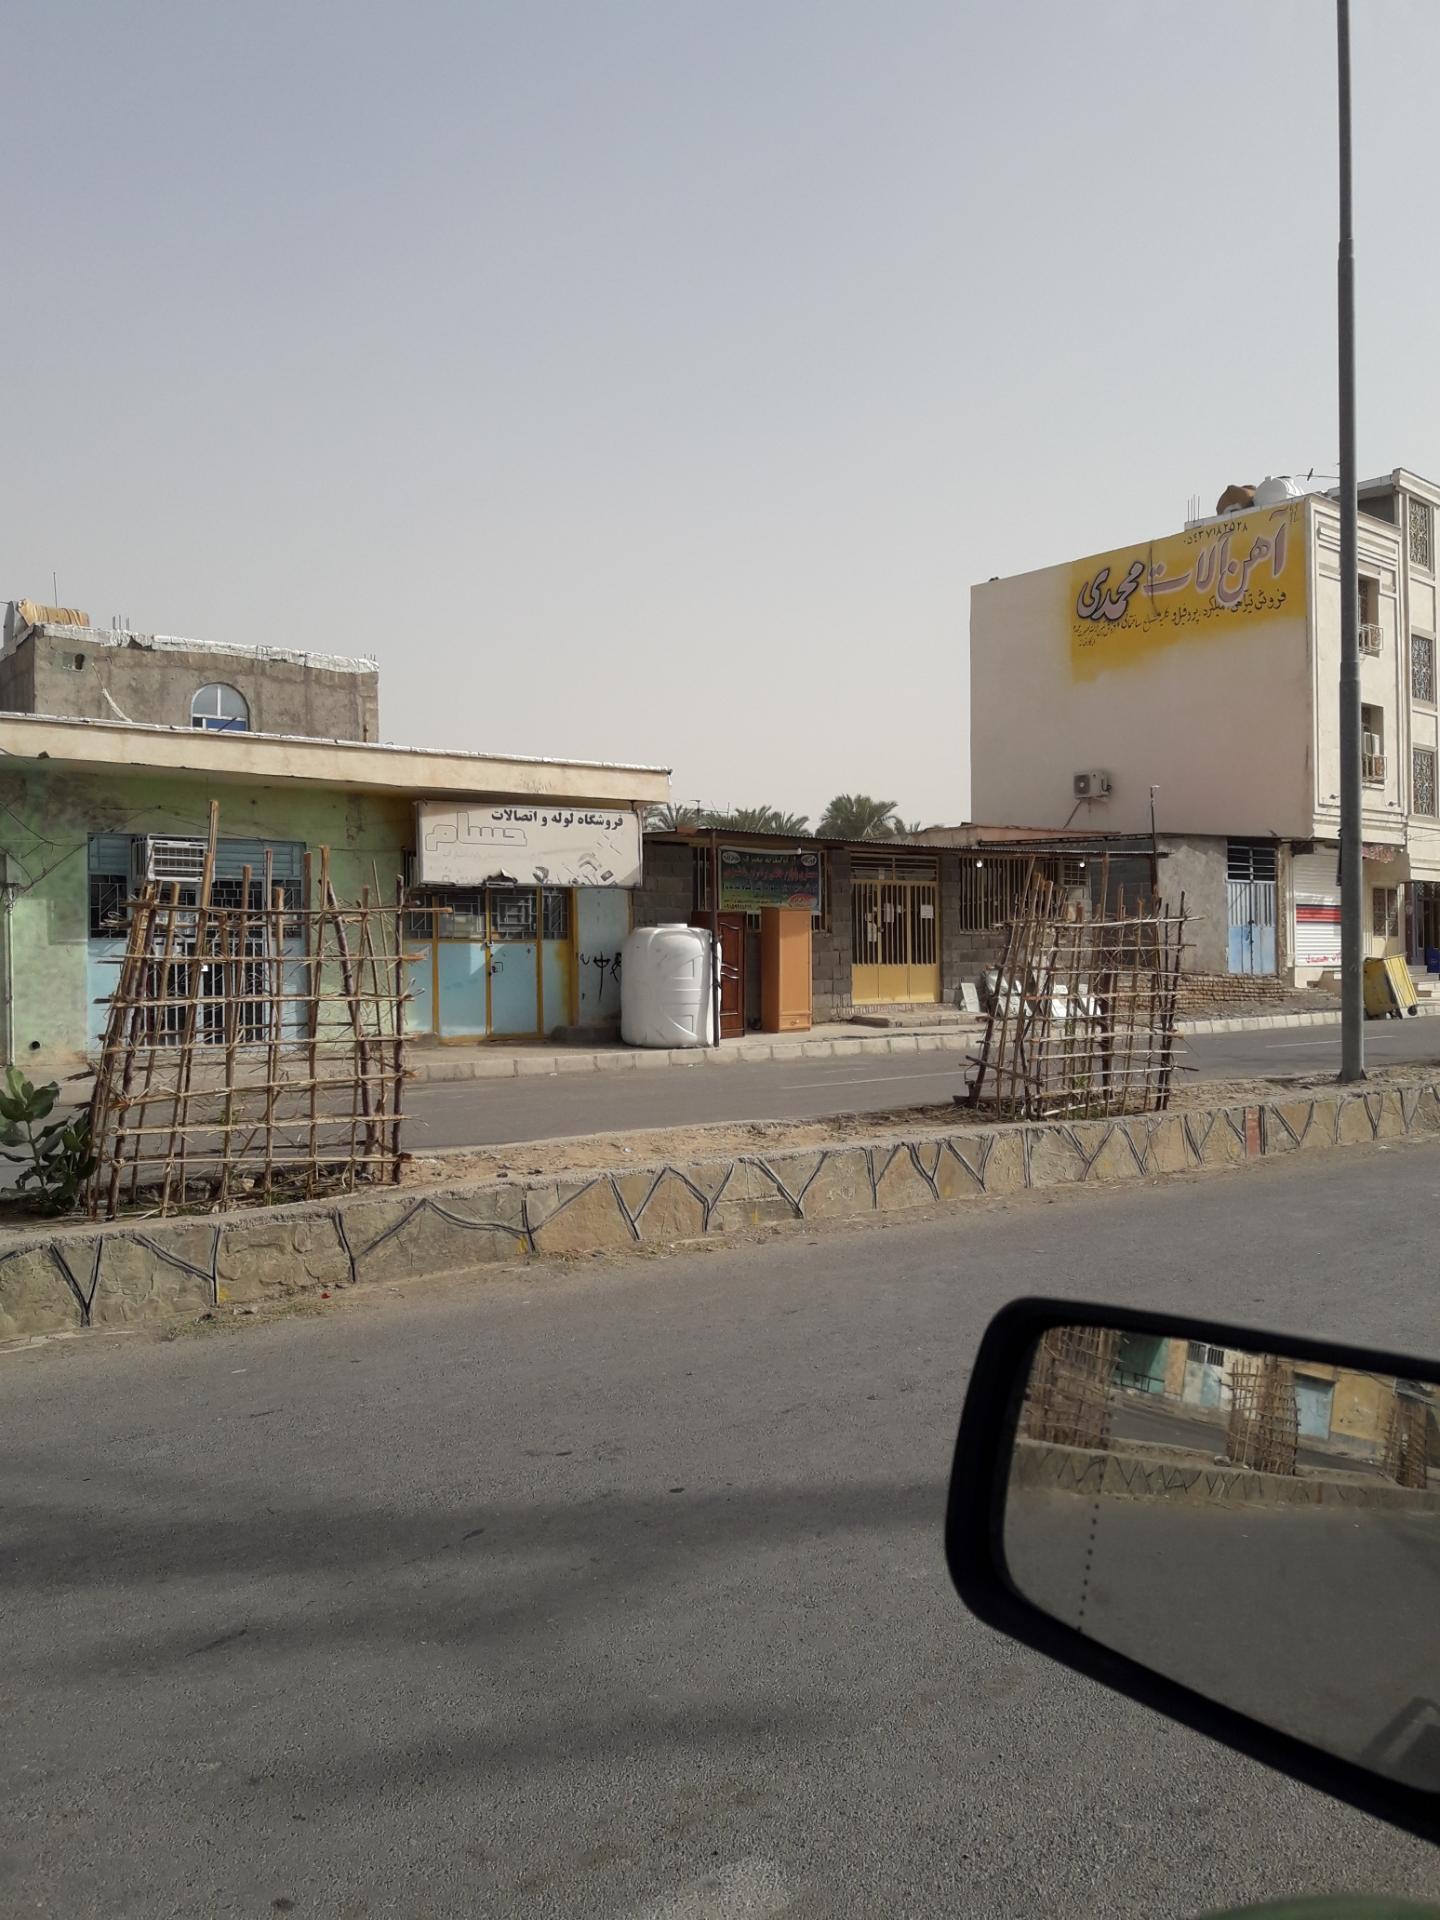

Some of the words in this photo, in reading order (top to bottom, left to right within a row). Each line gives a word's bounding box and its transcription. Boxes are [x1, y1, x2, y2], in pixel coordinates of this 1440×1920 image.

[1076, 560, 1145, 620] محمدی
[1255, 588, 1287, 609] فروش
[491, 809, 538, 822] اتصالات
[541, 815, 548, 826] و
[551, 812, 574, 829] لوله
[577, 814, 624, 830] فروشگاه
[425, 811, 528, 851] حسام
